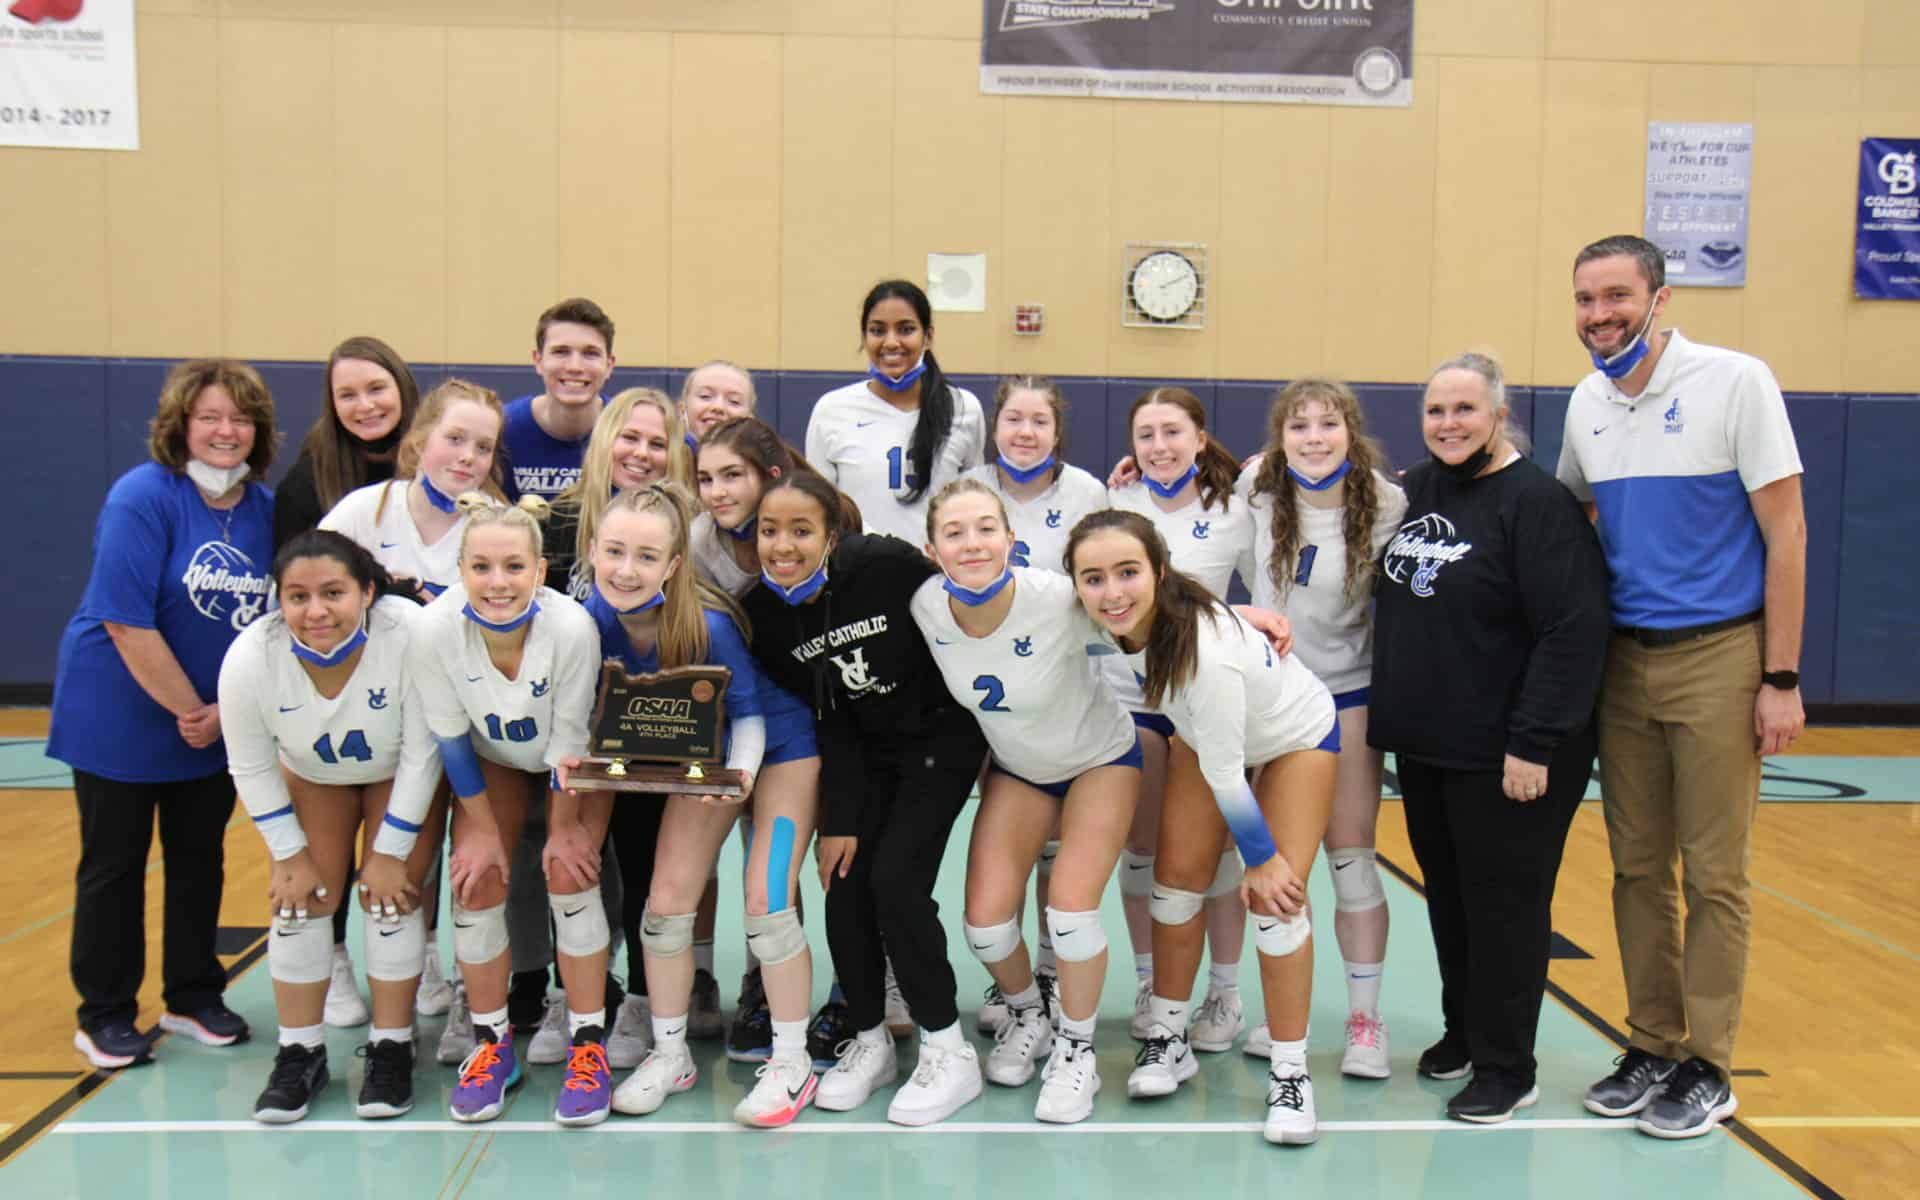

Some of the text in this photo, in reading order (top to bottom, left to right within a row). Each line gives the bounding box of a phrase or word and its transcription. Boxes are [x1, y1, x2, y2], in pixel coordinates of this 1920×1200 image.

[1015, 3, 1049, 16] STATE
[1051, 6, 1150, 20] CHAMPIONSHIPS
[1213, 14, 1372, 27] COMMUNITY CREDIT UNION
[997, 75, 1035, 86] PROUD
[1038, 76, 1083, 87] MEMBER
[1086, 78, 1099, 88] OF
[1172, 82, 1211, 92] SCHOOL
[1216, 83, 1272, 94] ACTIVITIES
[0, 106, 41, 123] 014
[59, 108, 112, 126] 2017
[1863, 195, 1920, 208] COLDWEL
[1871, 207, 1919, 219] BANKER
[1386, 532, 1472, 563] Volleyball
[791, 614, 888, 663] VALLEY CATHOLIC
[973, 674, 1012, 712] 2
[627, 696, 692, 719] OSAA
[484, 712, 538, 742] 10
[620, 722, 697, 736] 4A VOLLEYBALL
[313, 729, 373, 764] 14
